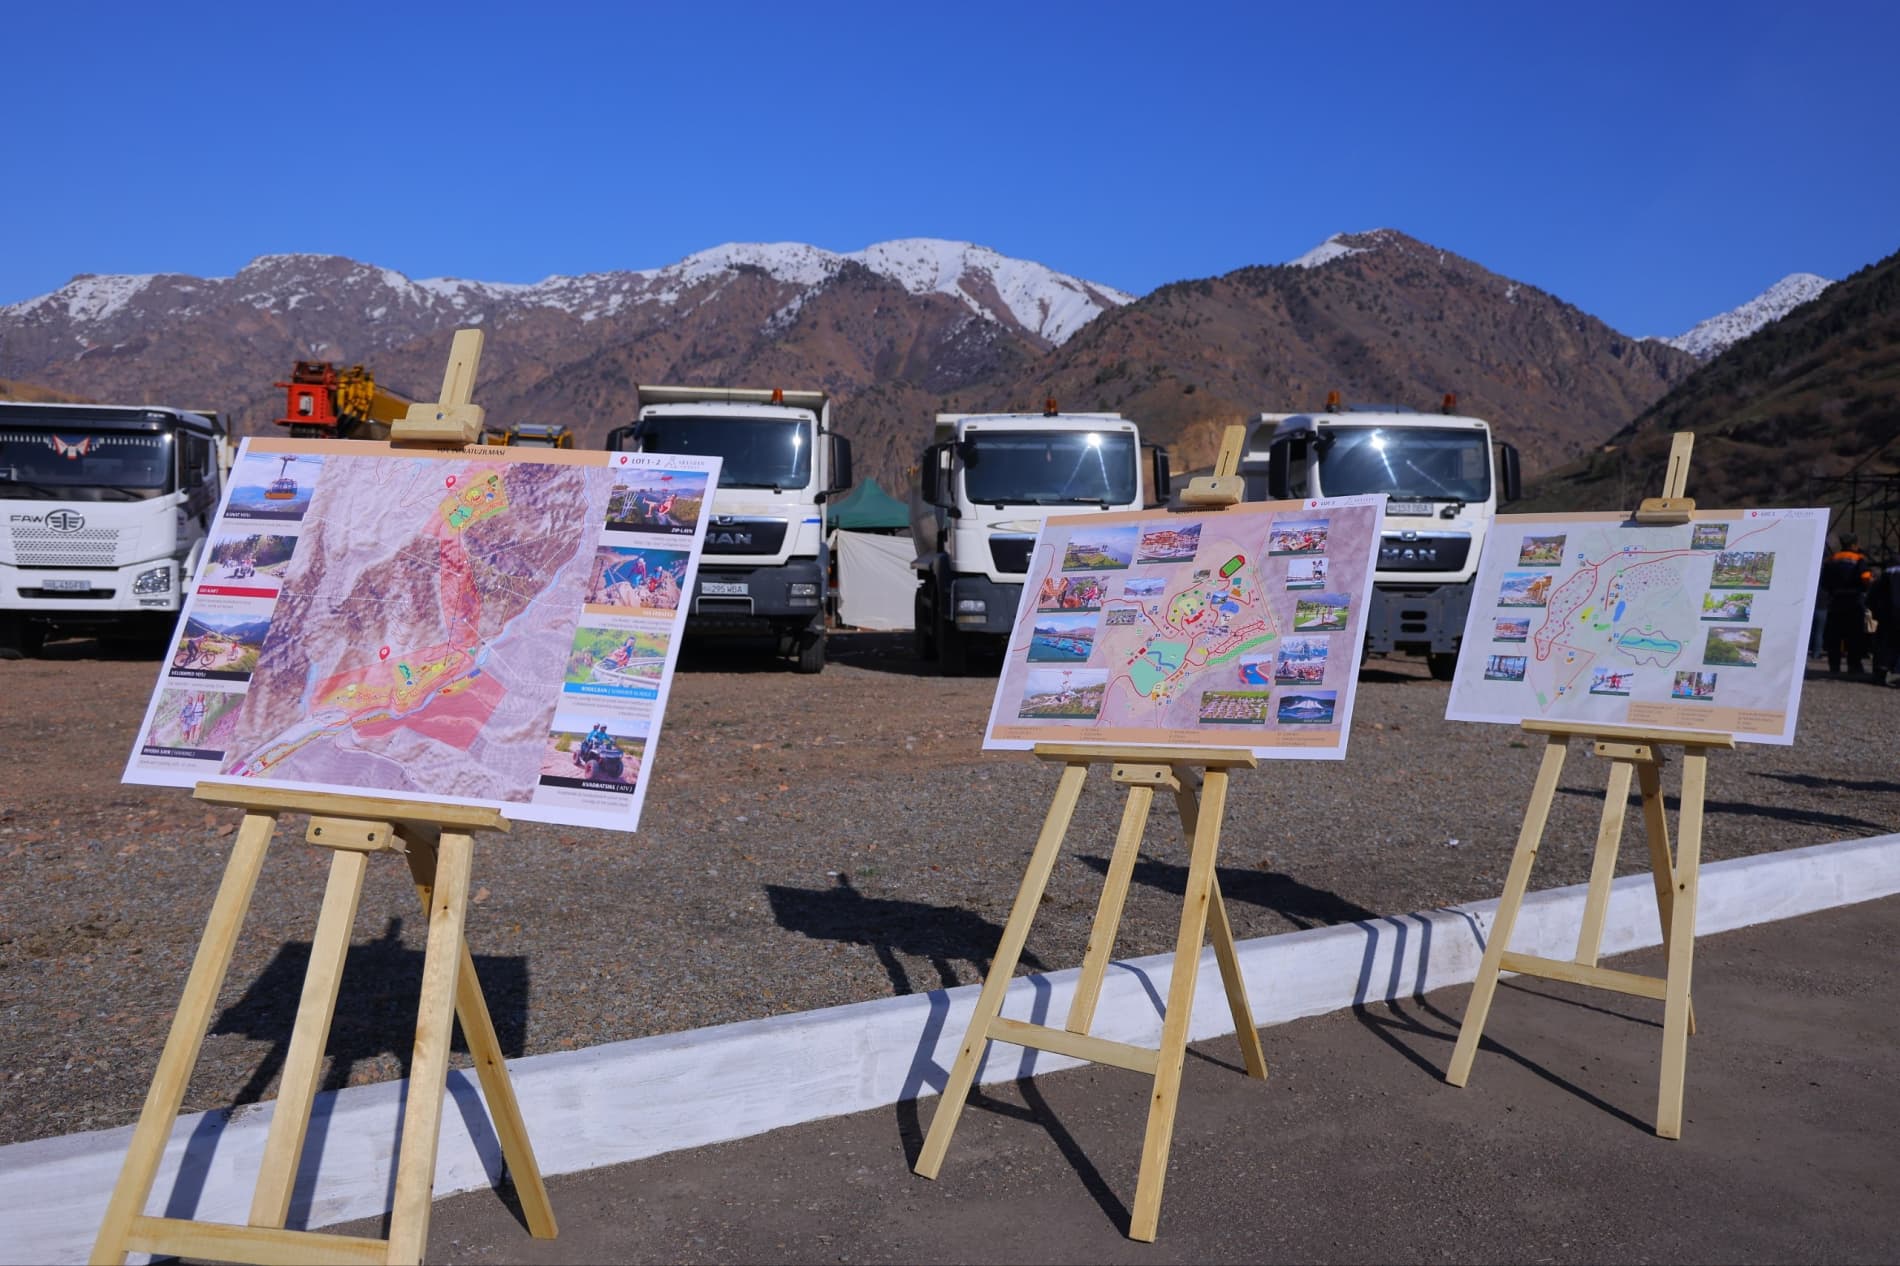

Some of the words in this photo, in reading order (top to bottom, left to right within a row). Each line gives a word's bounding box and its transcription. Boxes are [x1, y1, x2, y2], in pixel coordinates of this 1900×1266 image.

[631, 457, 645, 465] LOT
[10, 515, 44, 523] FAW
[1380, 548, 1437, 561] MAN
